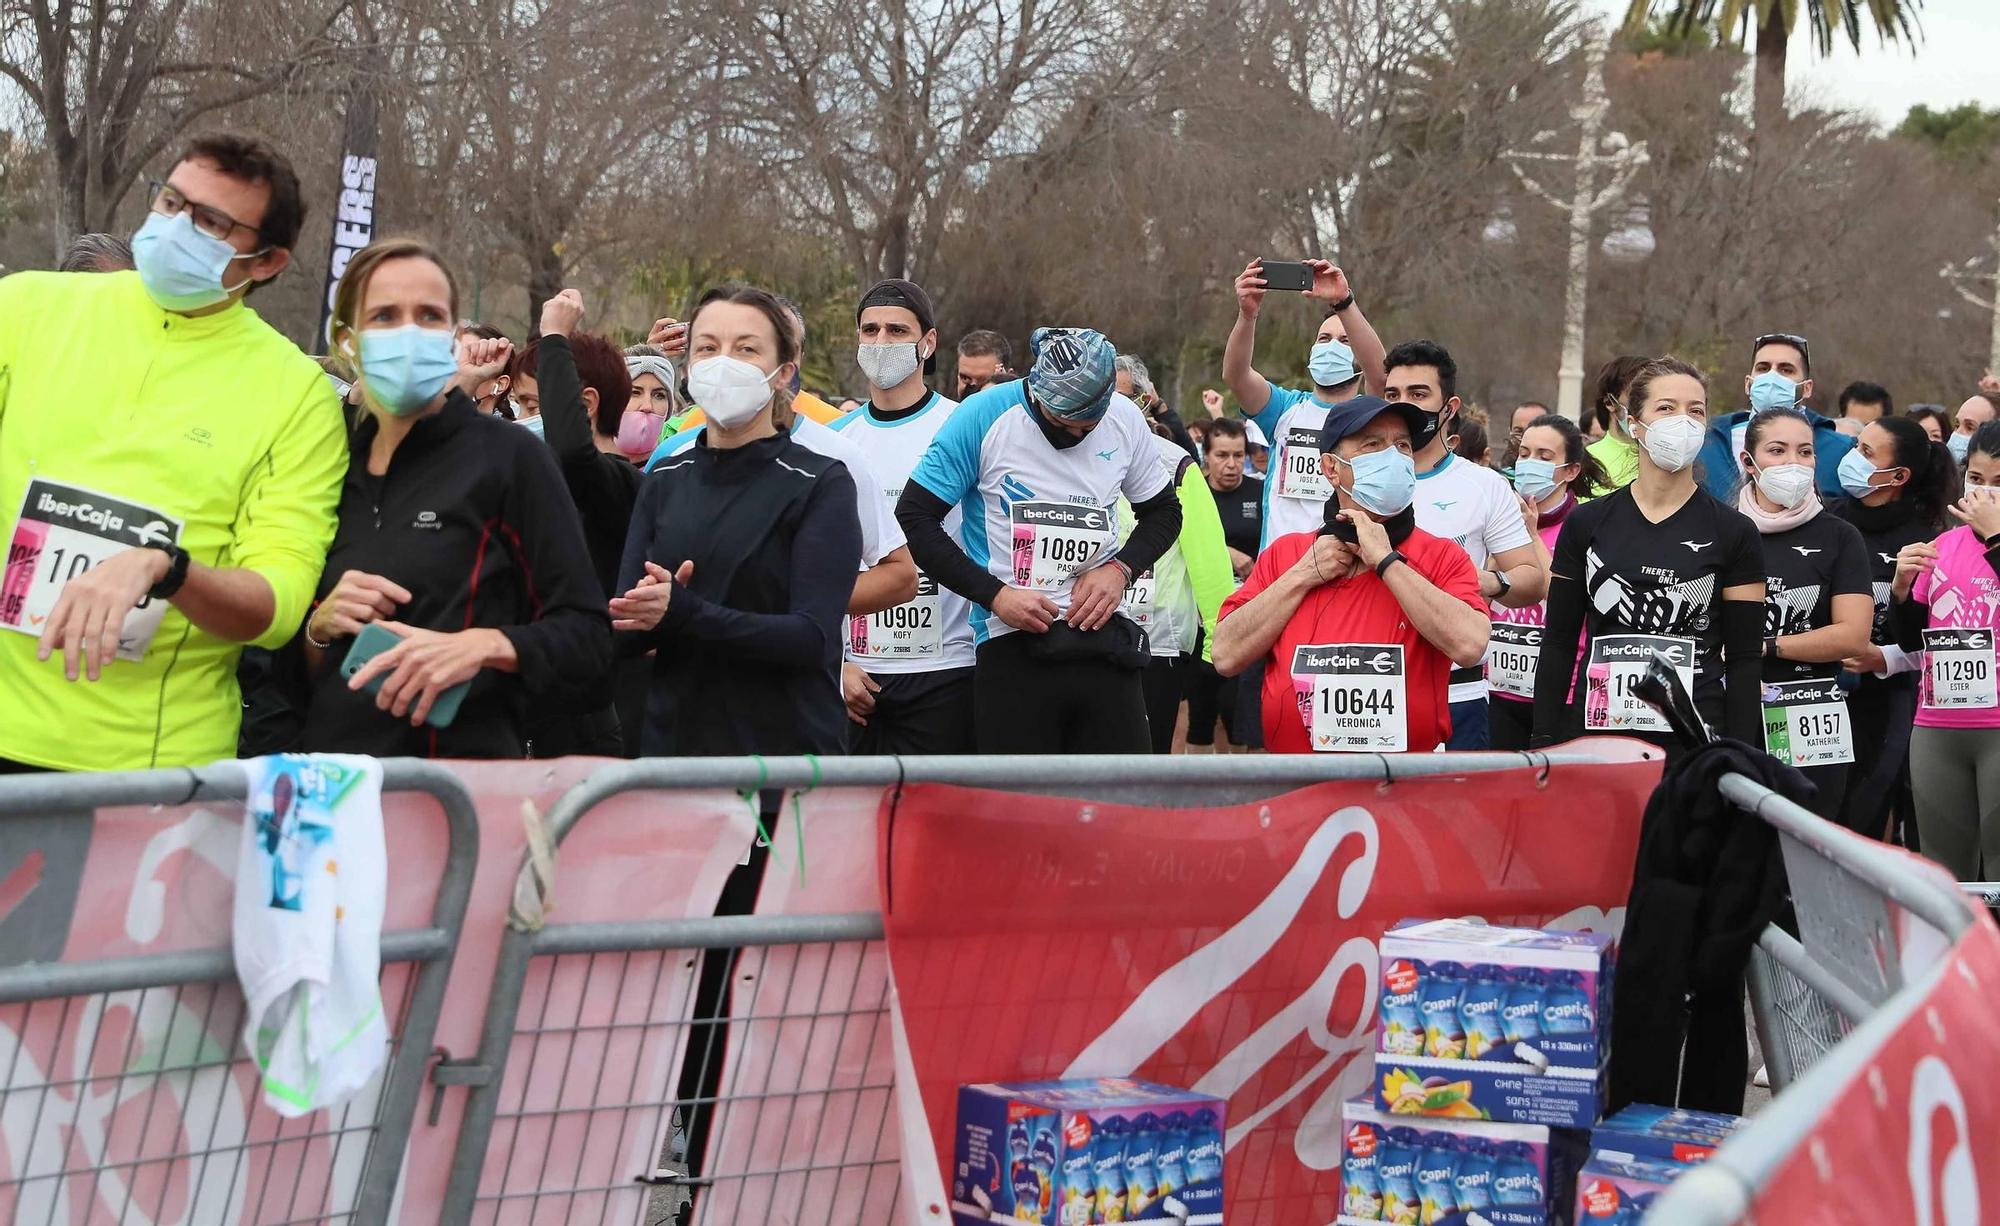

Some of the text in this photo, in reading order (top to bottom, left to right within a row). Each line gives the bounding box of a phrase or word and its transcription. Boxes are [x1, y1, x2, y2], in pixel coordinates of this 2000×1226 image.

[37, 493, 125, 531] iberCaja
[1023, 509, 1075, 523] iberCaja
[1041, 536, 1101, 562] 10897
[1018, 567, 1031, 580] 05
[1641, 565, 1675, 577] THERE'S
[1658, 576, 1680, 585] ONLY
[875, 606, 932, 629] 10902
[893, 631, 912, 640] KOFY
[1491, 629, 1519, 640] erCaja
[1928, 635, 1959, 647] iberCaja
[855, 636, 867, 649] 05
[1602, 644, 1653, 658] iberCaja
[1306, 653, 1360, 670] iberCaja
[1492, 650, 1539, 673] 10507
[1505, 672, 1524, 680] LAURA
[1935, 660, 1987, 681] 11290
[1950, 682, 1970, 691] ESTER
[1321, 687, 1395, 715] 10644
[1777, 688, 1822, 701] berCaja
[1624, 700, 1647, 709] DE LA
[1593, 707, 1607, 721] 05
[1336, 717, 1381, 729] VERONICA
[1799, 713, 1840, 737] 8157
[1807, 736, 1841, 747] KATHERINE
[1776, 748, 1790, 760] 04
[1383, 990, 1417, 1008] Capri
[1421, 997, 1456, 1014] Capri
[1462, 998, 1499, 1016] Capri
[1503, 1000, 1539, 1019] Capri
[1540, 1040, 1550, 1049] 15
[1505, 1096, 1531, 1107] sans
[1513, 1109, 1527, 1119] no
[1063, 1152, 1091, 1174] Capri
[1094, 1152, 1121, 1174] Capri
[1126, 1148, 1153, 1170] Capri
[1157, 1145, 1184, 1167] Capri
[1345, 1155, 1377, 1171] Capri
[1380, 1162, 1412, 1178] Capri
[1418, 1167, 1451, 1184] Capri
[1455, 1171, 1490, 1189] Capri
[1491, 1211, 1500, 1220] 15
